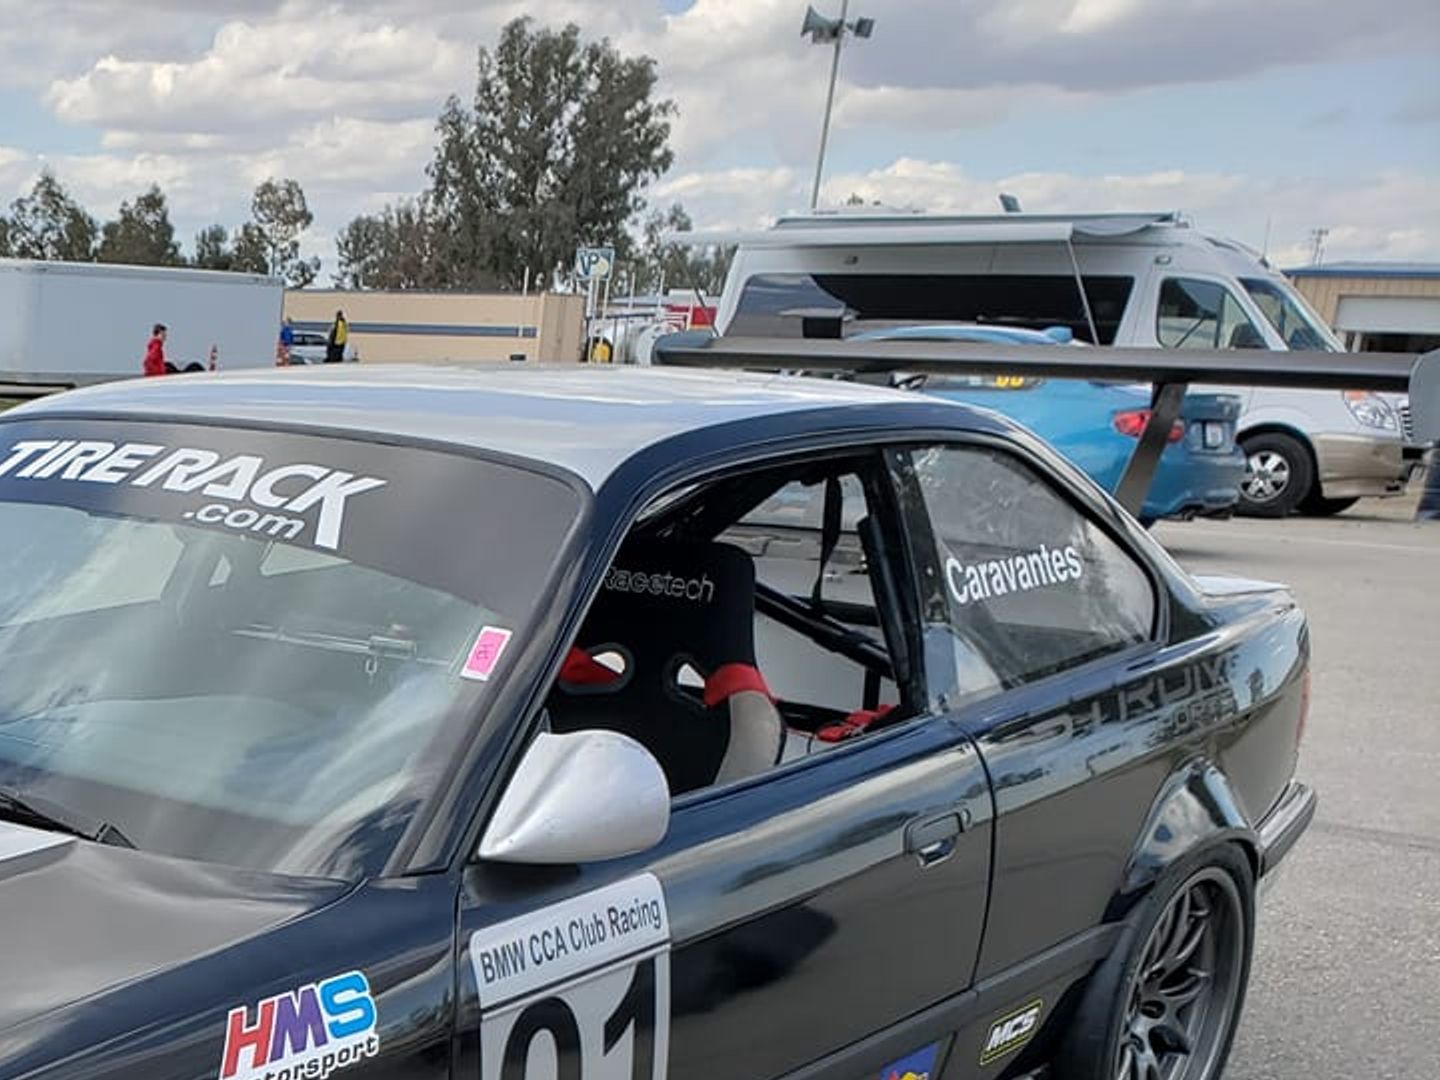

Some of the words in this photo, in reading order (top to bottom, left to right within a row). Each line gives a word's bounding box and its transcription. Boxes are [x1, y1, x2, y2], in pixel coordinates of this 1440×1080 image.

[182, 503, 306, 540] .com
[945, 544, 1082, 604] Caravantes
[480, 939, 526, 985] BMW
[529, 926, 567, 966] CCA
[569, 912, 606, 951] Club
[607, 898, 661, 939] Racing
[222, 972, 376, 1080] HMS
